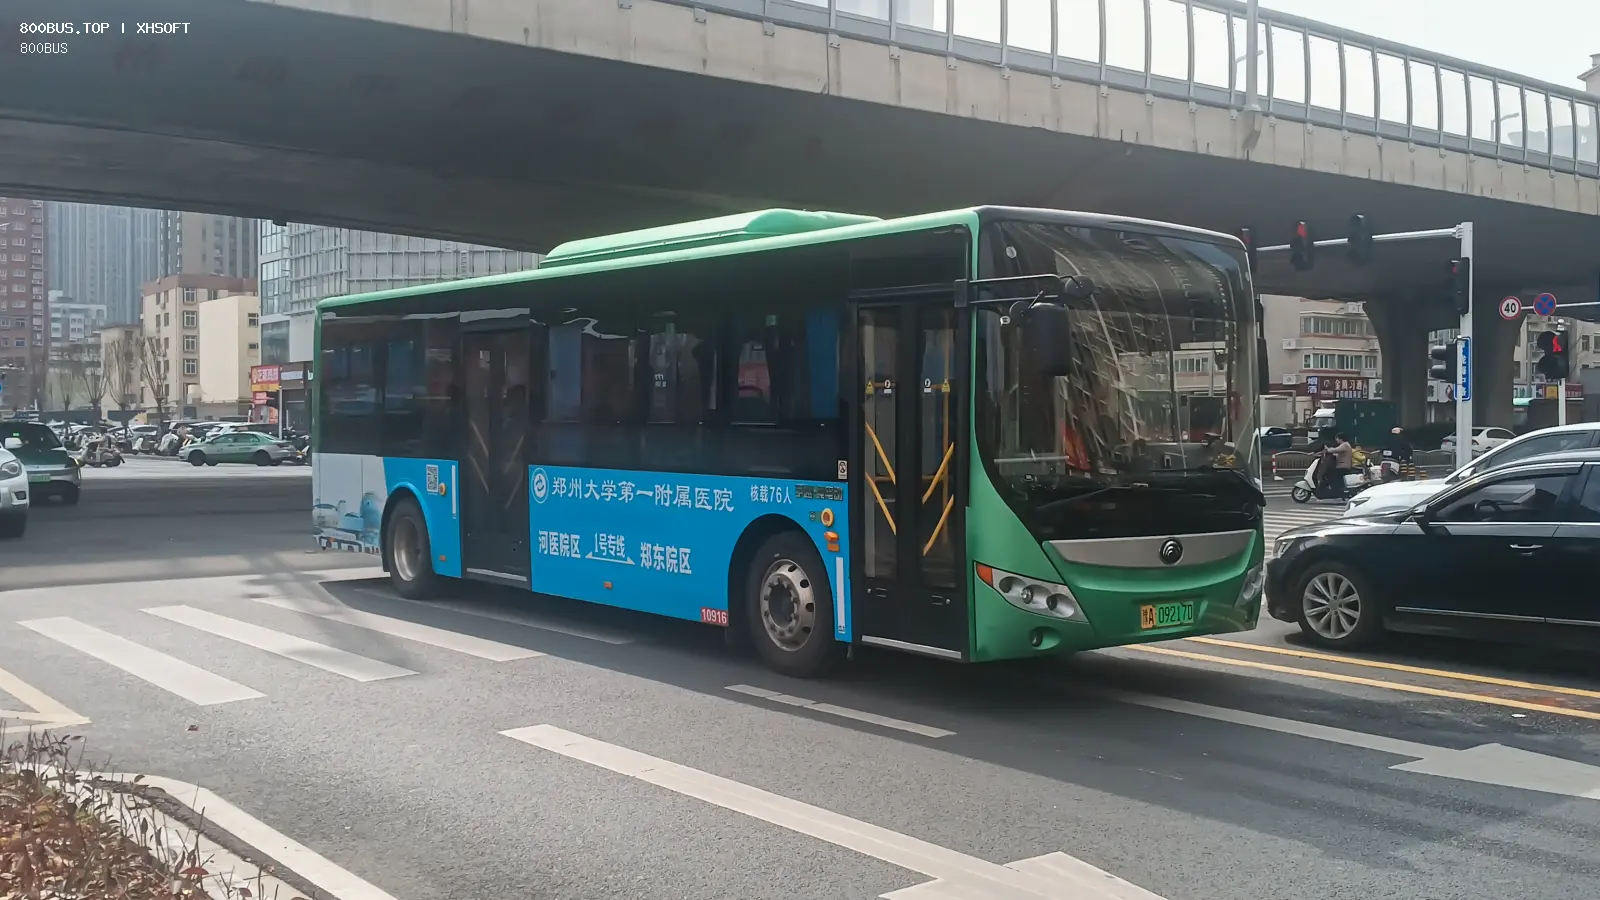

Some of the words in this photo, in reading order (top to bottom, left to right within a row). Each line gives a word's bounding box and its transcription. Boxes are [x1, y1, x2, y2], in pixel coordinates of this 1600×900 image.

[1503, 302, 1517, 314] 40
[551, 476, 735, 513] 郑州大学第一附属医院
[750, 484, 792, 505] 核载76人
[538, 529, 582, 559] 河医院区
[594, 532, 626, 559] 1号专线
[640, 541, 693, 575] 郑东院区
[701, 608, 728, 624] 10916
